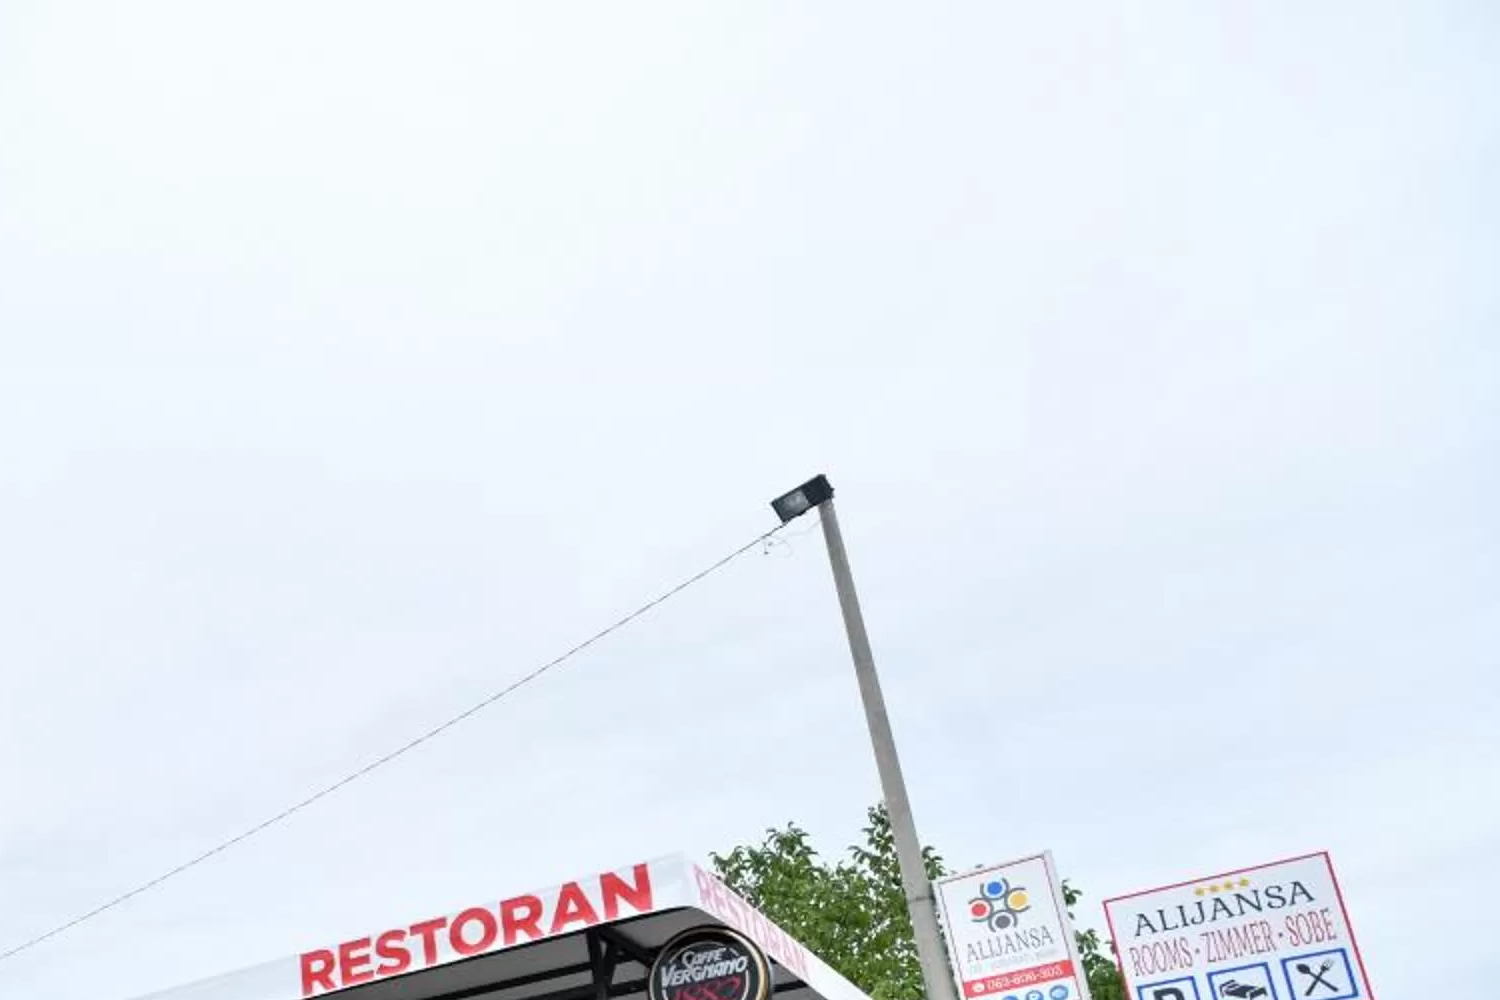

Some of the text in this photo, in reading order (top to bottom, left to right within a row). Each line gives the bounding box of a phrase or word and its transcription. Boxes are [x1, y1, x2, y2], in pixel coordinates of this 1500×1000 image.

[299, 862, 654, 997] RESTORAN
[1129, 907, 1338, 978] ROOMS ZIMMER SOBE
[1133, 880, 1316, 938] ALIJANSA
